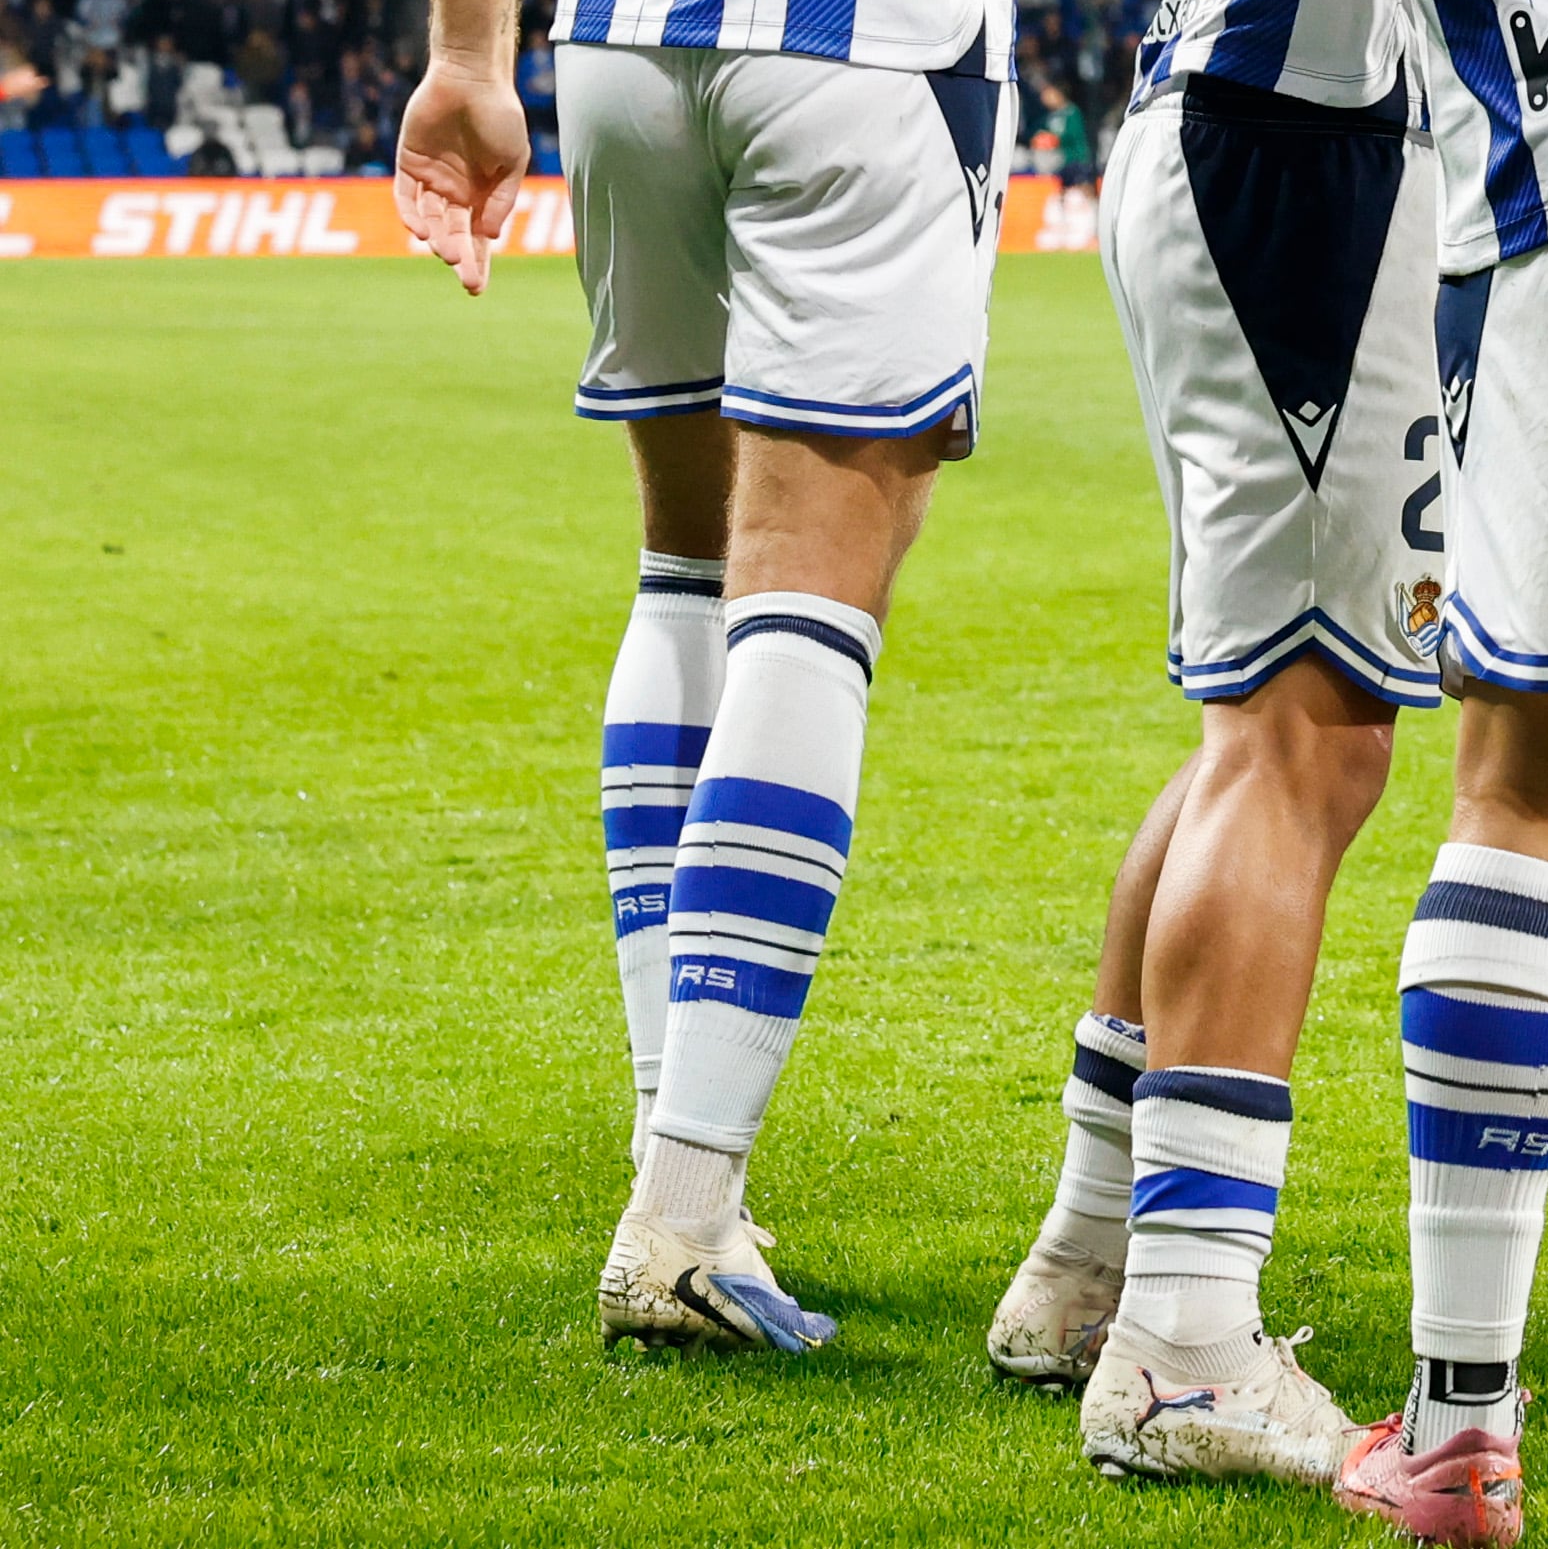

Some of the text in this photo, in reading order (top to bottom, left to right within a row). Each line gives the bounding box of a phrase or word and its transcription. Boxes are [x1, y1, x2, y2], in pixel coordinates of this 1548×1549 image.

[92, 191, 359, 255] STIHL
[617, 893, 666, 920] RS
[678, 964, 736, 990] RS
